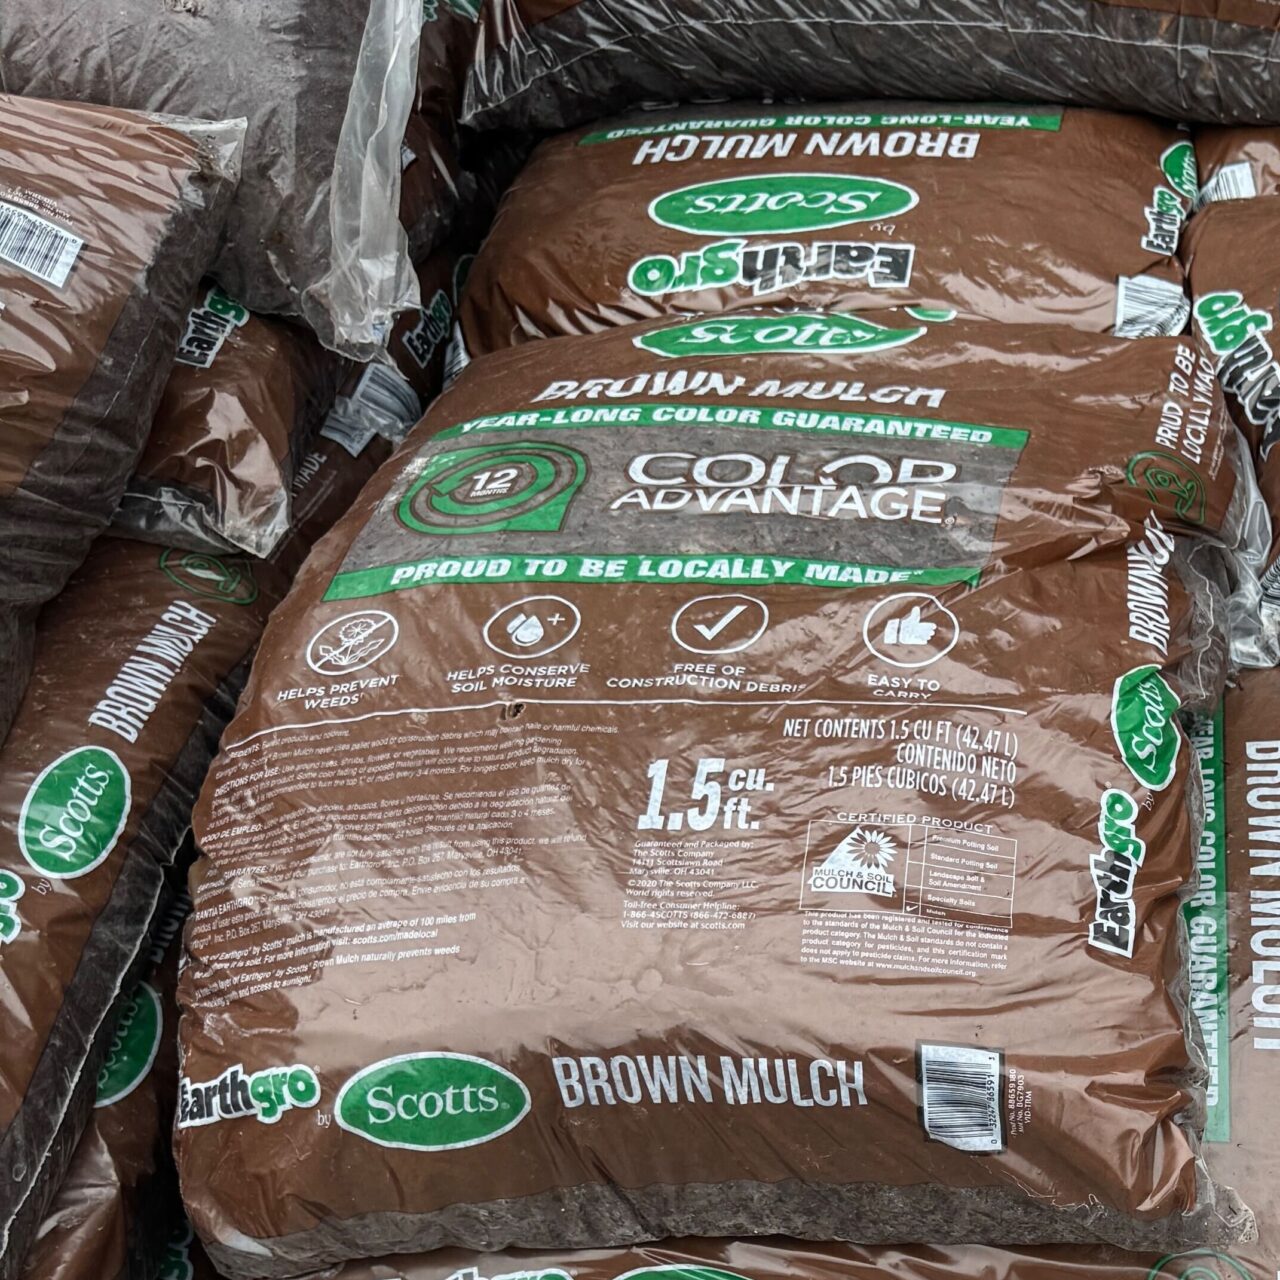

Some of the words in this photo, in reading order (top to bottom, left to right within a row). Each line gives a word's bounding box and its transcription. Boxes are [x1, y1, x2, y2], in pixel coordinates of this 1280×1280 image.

[608, 118, 777, 140] GUARANTEED
[785, 114, 871, 127] COLOR
[881, 115, 1031, 127] YEAR-LONG
[632, 132, 799, 165] MULCH
[804, 132, 980, 158] BROWN
[686, 192, 882, 215] Scotts
[870, 222, 896, 236] by
[628, 239, 915, 296] Earthgro
[531, 371, 746, 403] BROWN
[748, 379, 947, 408] MULCH
[461, 406, 643, 434] YEAR-LONG
[652, 406, 762, 426] COLOR
[772, 411, 993, 445] GUARANTEED
[470, 468, 519, 489] 12
[390, 557, 510, 586] PROUD
[524, 558, 569, 577] TO
[579, 557, 628, 579] BE
[637, 557, 797, 580] LOCALLY
[88, 653, 176, 744] BROWN
[136, 600, 217, 666] MULCH
[446, 665, 494, 682] HELPS
[500, 662, 591, 680] CONSERVE
[673, 663, 719, 677] FREE
[723, 664, 746, 677] OF
[277, 684, 325, 702] HELPS
[329, 675, 400, 694] PREVENT
[451, 679, 488, 694] SOIL
[492, 676, 578, 692] MOISTURE
[606, 675, 742, 692] CONSTRUCTION
[868, 674, 909, 690] EASY
[917, 678, 941, 692] TO
[873, 689, 932, 701] CARRY
[783, 718, 811, 738] NET
[815, 718, 886, 740] CONTENTS
[890, 720, 910, 741] 1.5
[913, 720, 933, 741] CU
[936, 721, 952, 744] FT
[955, 723, 1002, 754] (42.47
[1004, 732, 1018, 760] L)
[638, 758, 726, 831] 1.5
[728, 768, 775, 792] cu.
[38, 762, 112, 861] Scotts
[723, 797, 760, 830] ft.
[837, 812, 916, 825] CERTIFIED
[922, 815, 994, 834] PRODUCT
[812, 876, 893, 895] COUNCIL
[814, 868, 853, 878] MULCH
[856, 871, 864, 879] &
[867, 873, 893, 883] SOIL
[31, 878, 53, 896] by
[178, 1064, 320, 1128] Earthgro
[317, 1109, 331, 1127] by
[367, 1080, 502, 1124] Scotts
[553, 1054, 709, 1108] BROWN
[721, 1058, 868, 1107] MULCH
